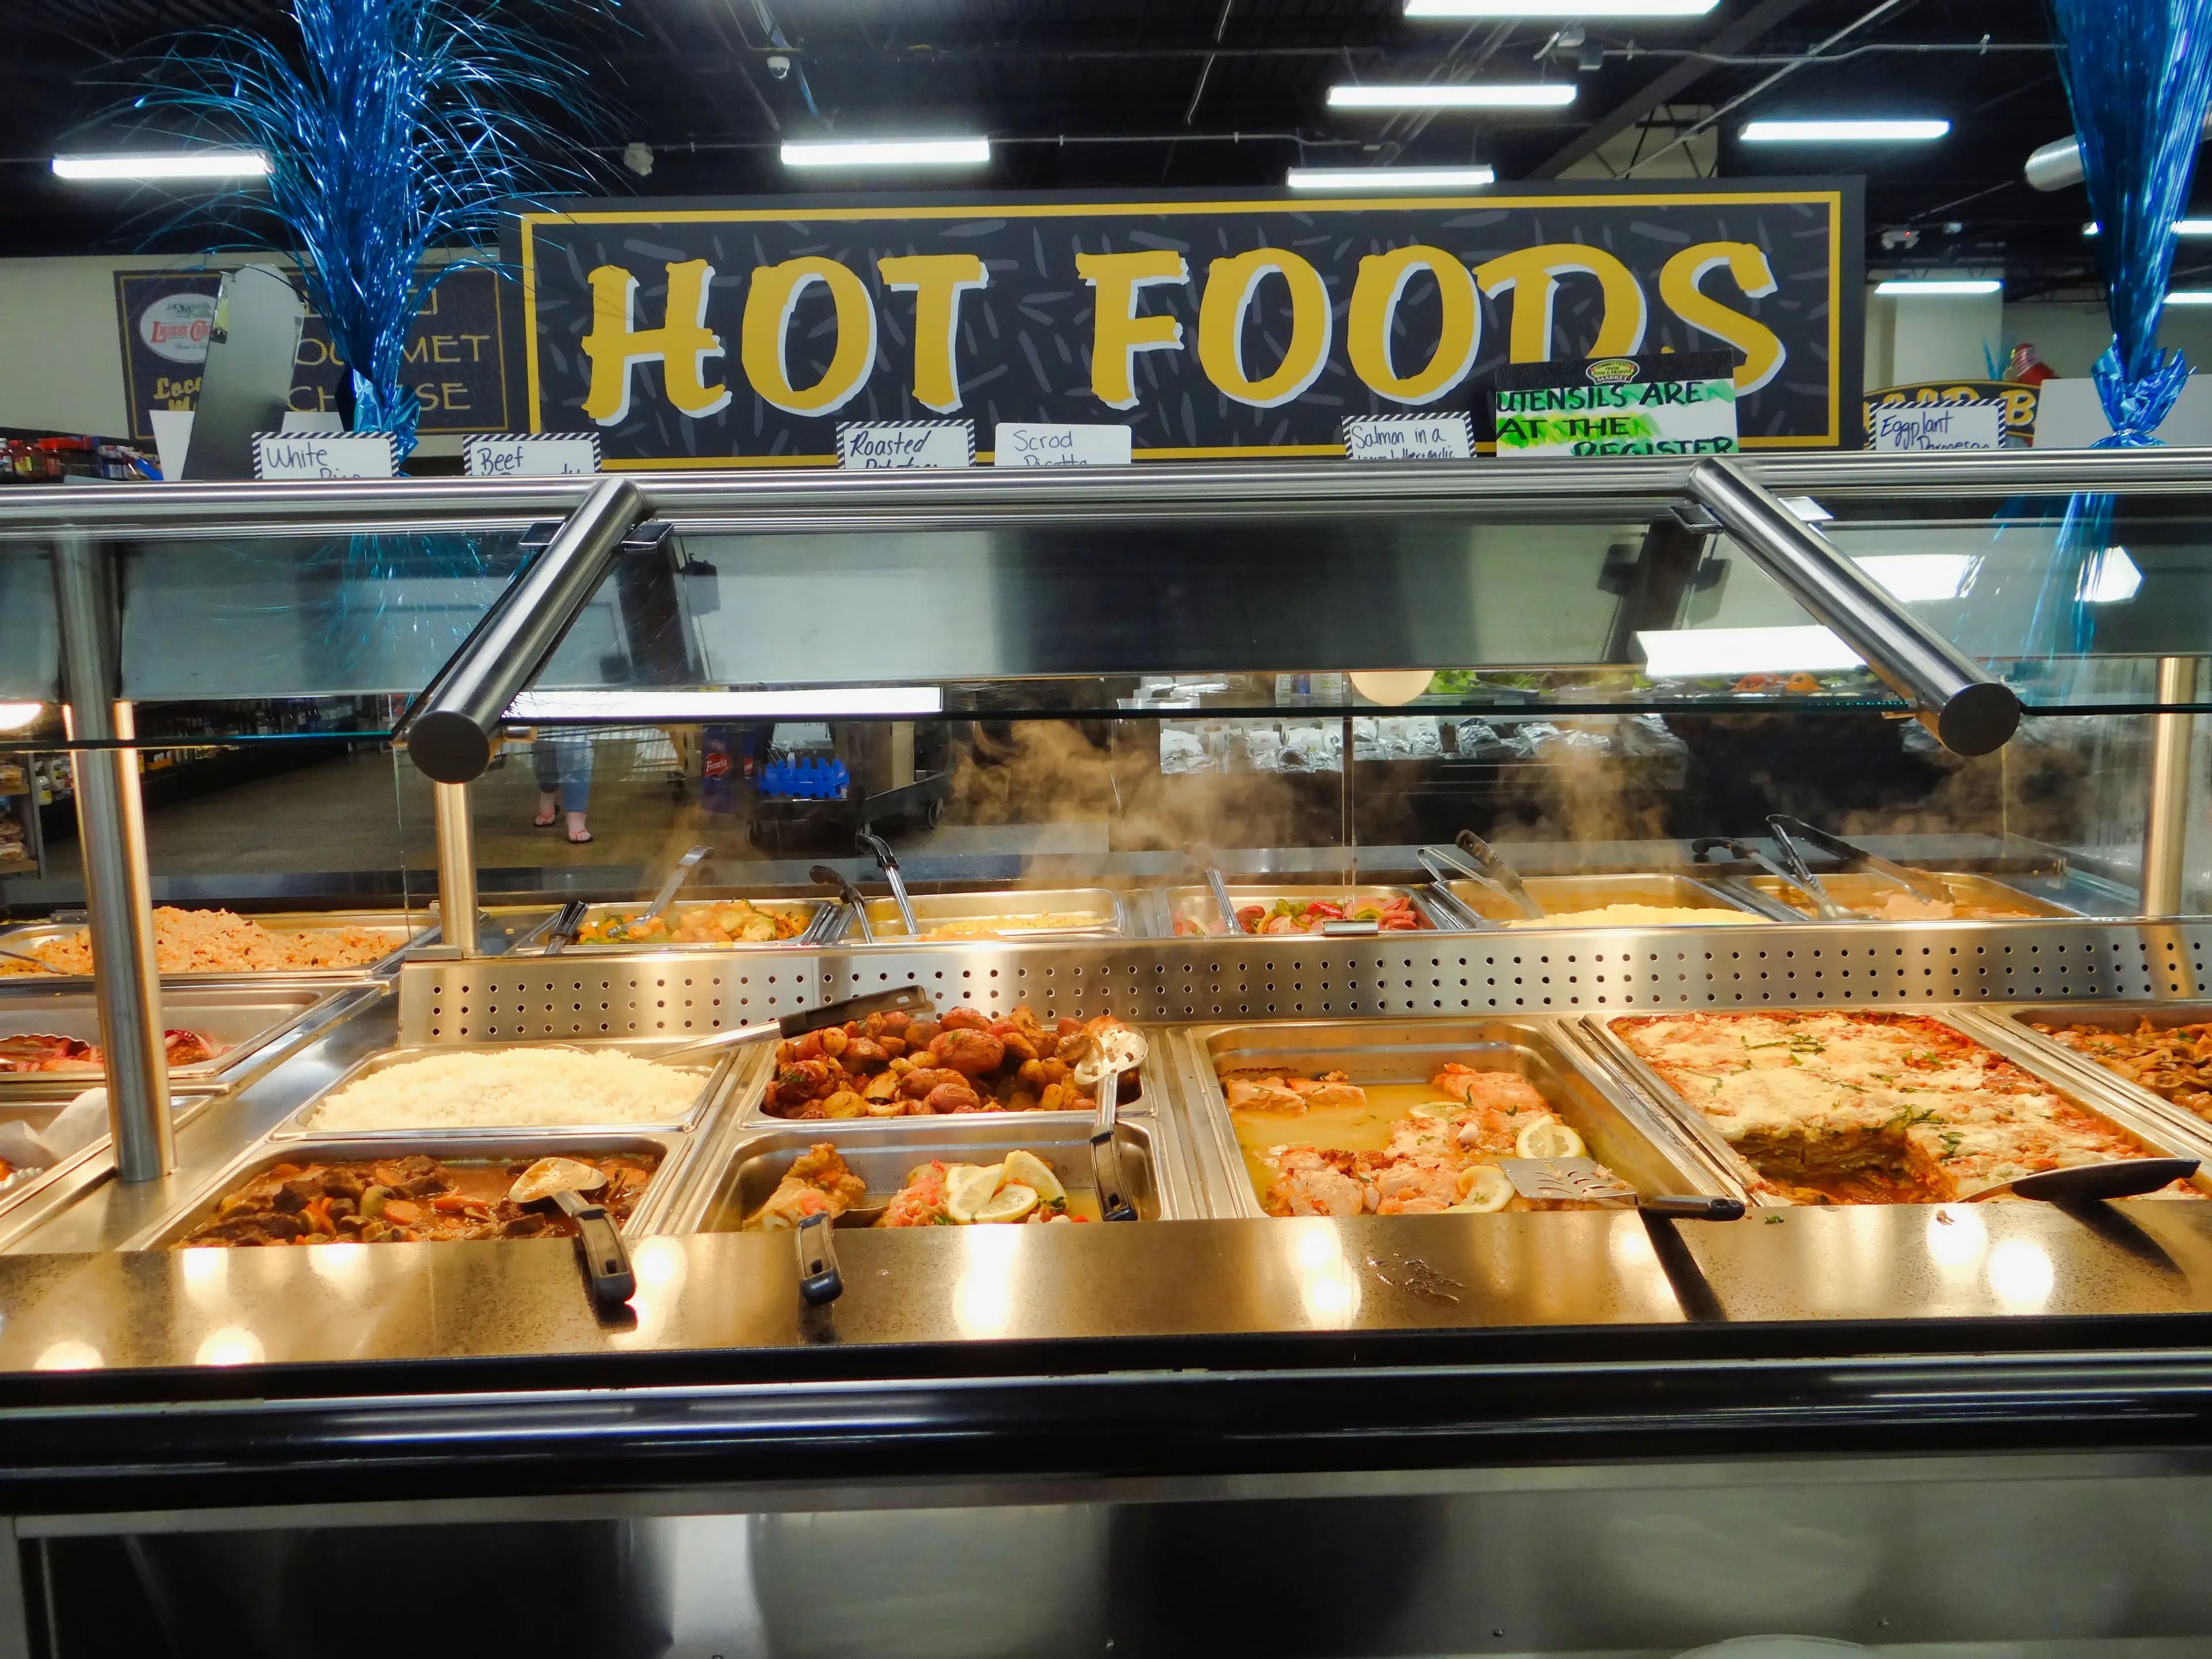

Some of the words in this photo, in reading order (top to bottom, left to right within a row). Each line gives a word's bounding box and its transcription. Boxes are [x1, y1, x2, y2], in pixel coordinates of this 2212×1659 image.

[581, 254, 990, 426] HOT
[1075, 241, 1786, 410] FOODS
[1497, 384, 1627, 412] UTENSILS
[1639, 381, 1705, 406] ARE
[1013, 430, 1073, 452] Scrod
[1351, 426, 1405, 449] Salmon
[1414, 427, 1427, 445] in
[1431, 428, 1447, 442] a
[1496, 418, 1548, 440] AT
[1561, 417, 1631, 437] THE
[1880, 410, 1955, 449] Eggplant
[266, 441, 329, 469] White
[850, 430, 932, 457] Roasted
[476, 445, 524, 472] Beef
